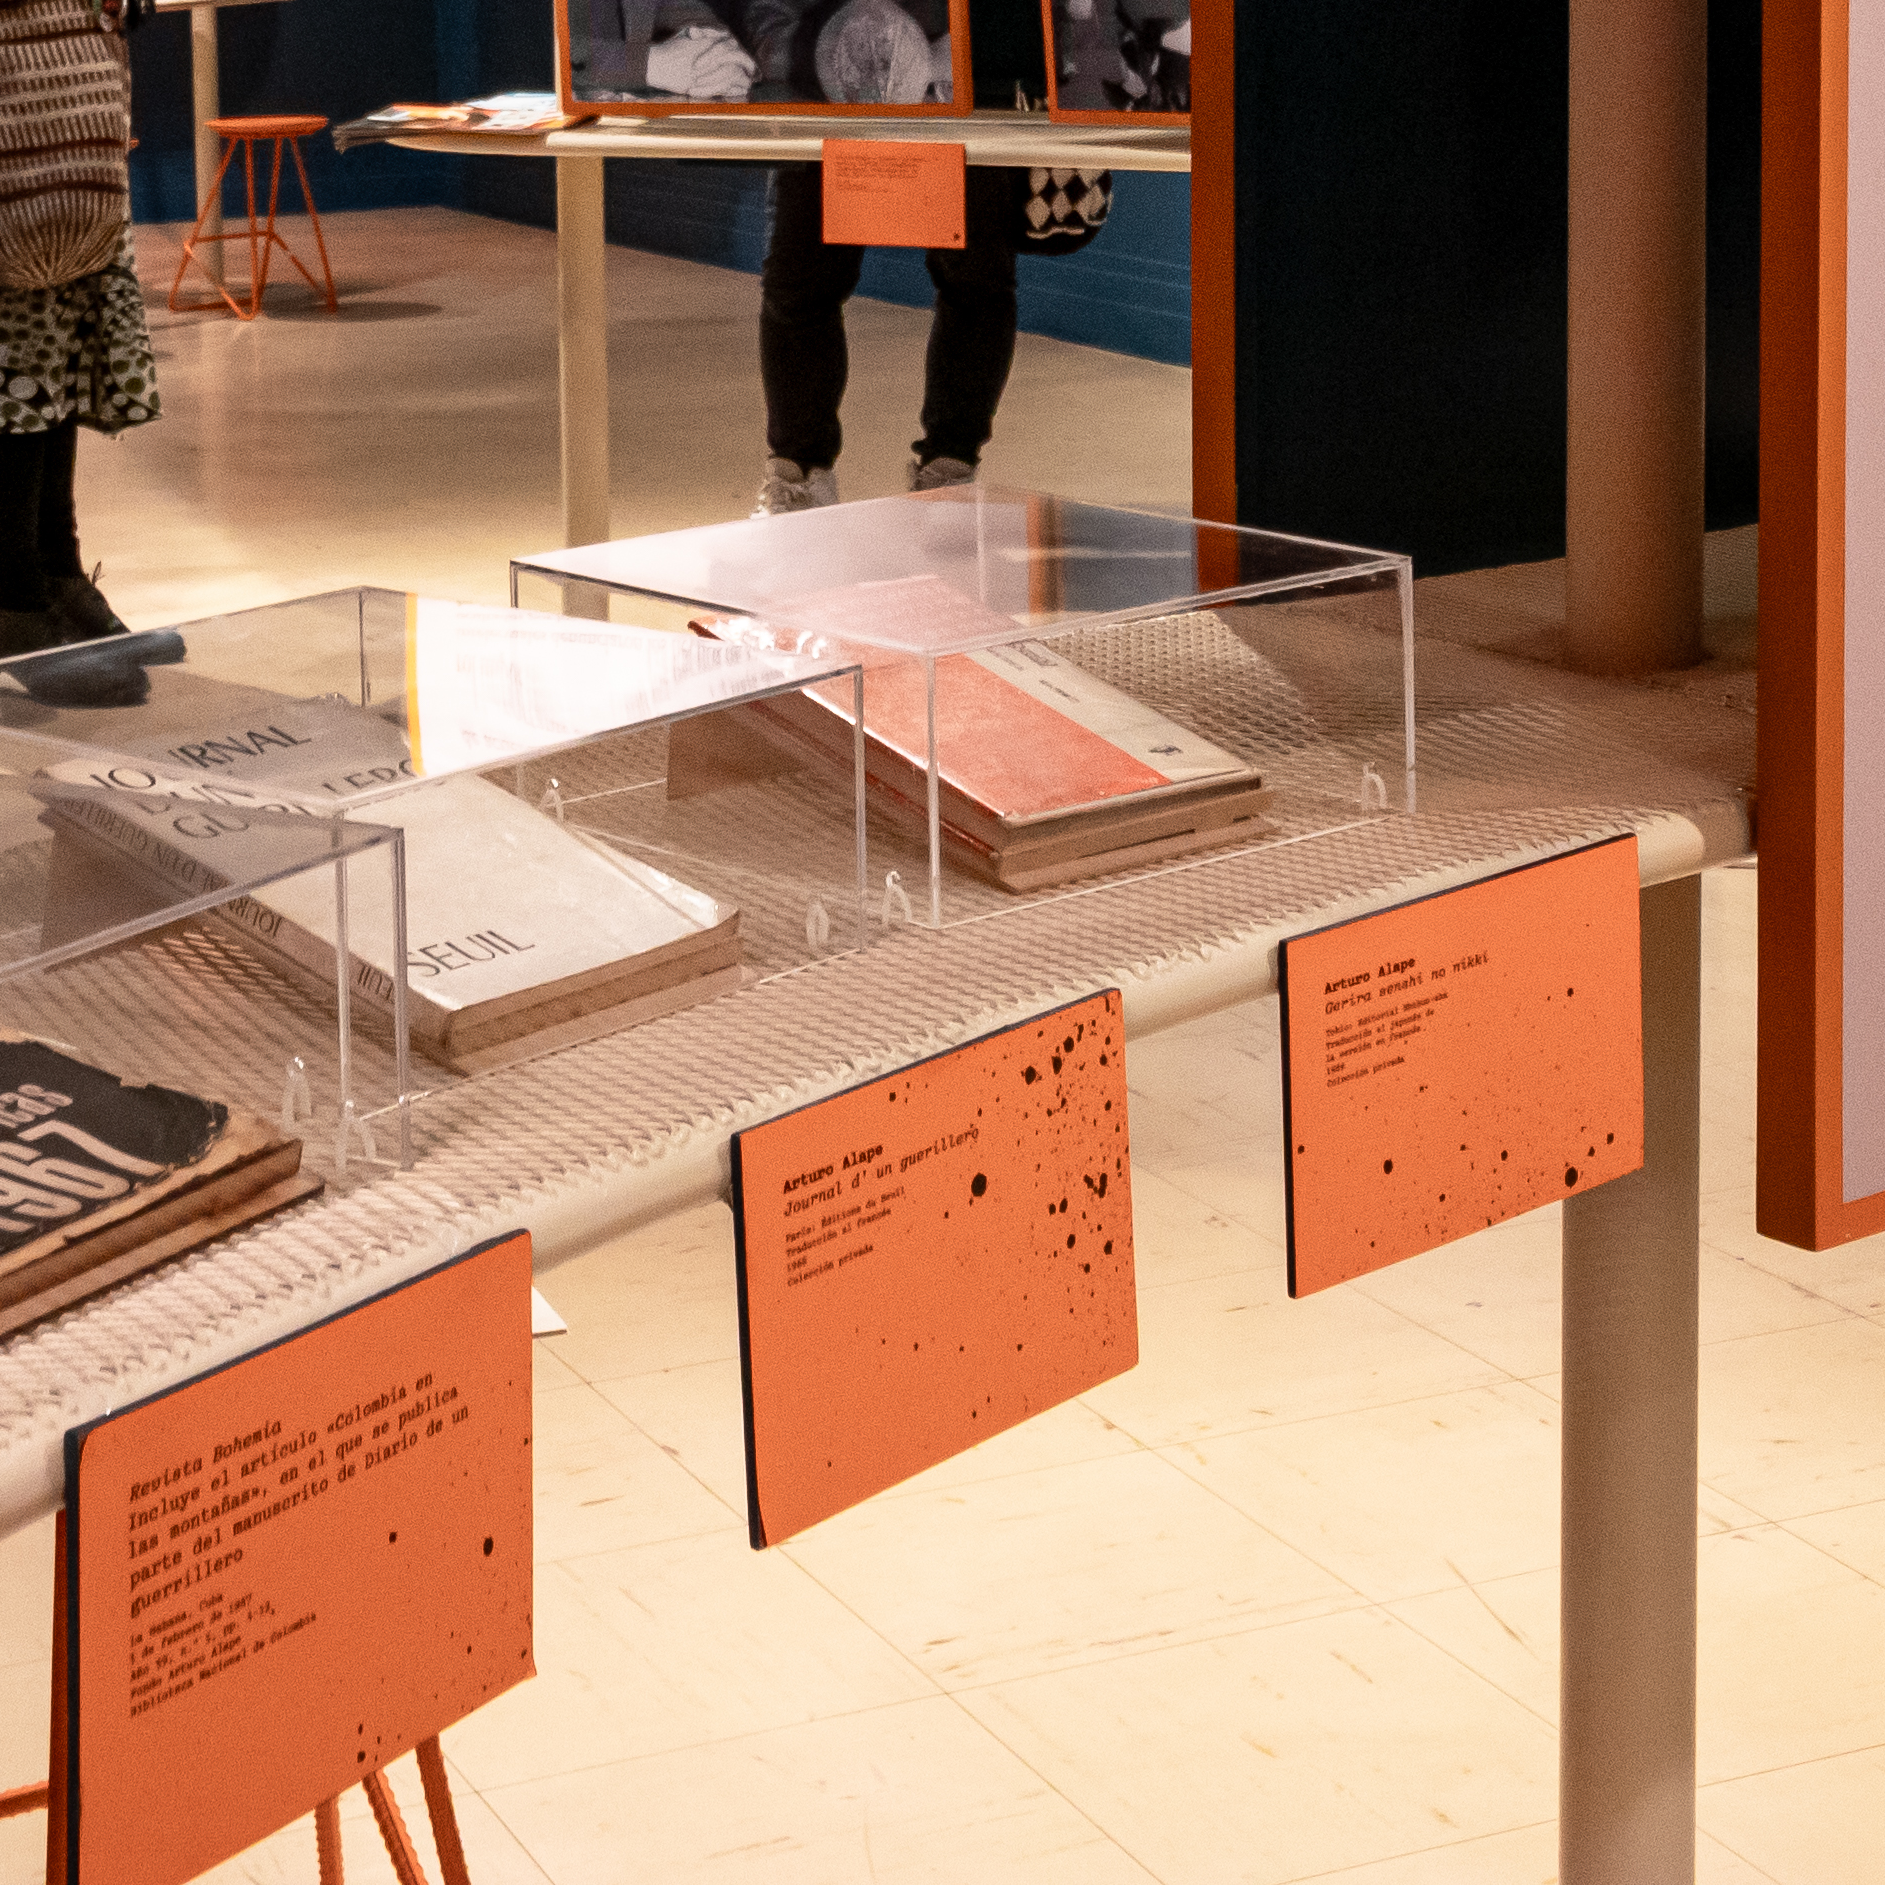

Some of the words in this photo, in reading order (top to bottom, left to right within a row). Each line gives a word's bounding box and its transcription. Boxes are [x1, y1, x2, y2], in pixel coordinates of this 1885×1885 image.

[407, 929, 536, 978] SEUIL
[1323, 971, 1372, 995] Arturo
[1377, 957, 1416, 979] Alape
[782, 1163, 835, 1195] Arturo
[841, 1143, 884, 1171] Alape
[782, 1179, 843, 1217] Journal
[875, 1163, 893, 1180] un
[128, 1487, 201, 1533] Incluye
[210, 1469, 231, 1493] el
[414, 1371, 434, 1392] en
[128, 1533, 160, 1561] las
[278, 1465, 300, 1487] en
[307, 1449, 327, 1473] el
[334, 1433, 364, 1461] que
[371, 1420, 390, 1441] se
[397, 1384, 460, 1428] publica
[129, 1456, 204, 1504] Revista
[212, 1418, 283, 1464] Bohemia
[129, 1547, 184, 1593] parte
[192, 1526, 222, 1557] del
[232, 1477, 330, 1538] manuscrito
[336, 1462, 357, 1484] de
[364, 1430, 419, 1470] Diario
[425, 1418, 445, 1440] de
[451, 1405, 471, 1429] un
[129, 1547, 245, 1620] guerrillero
